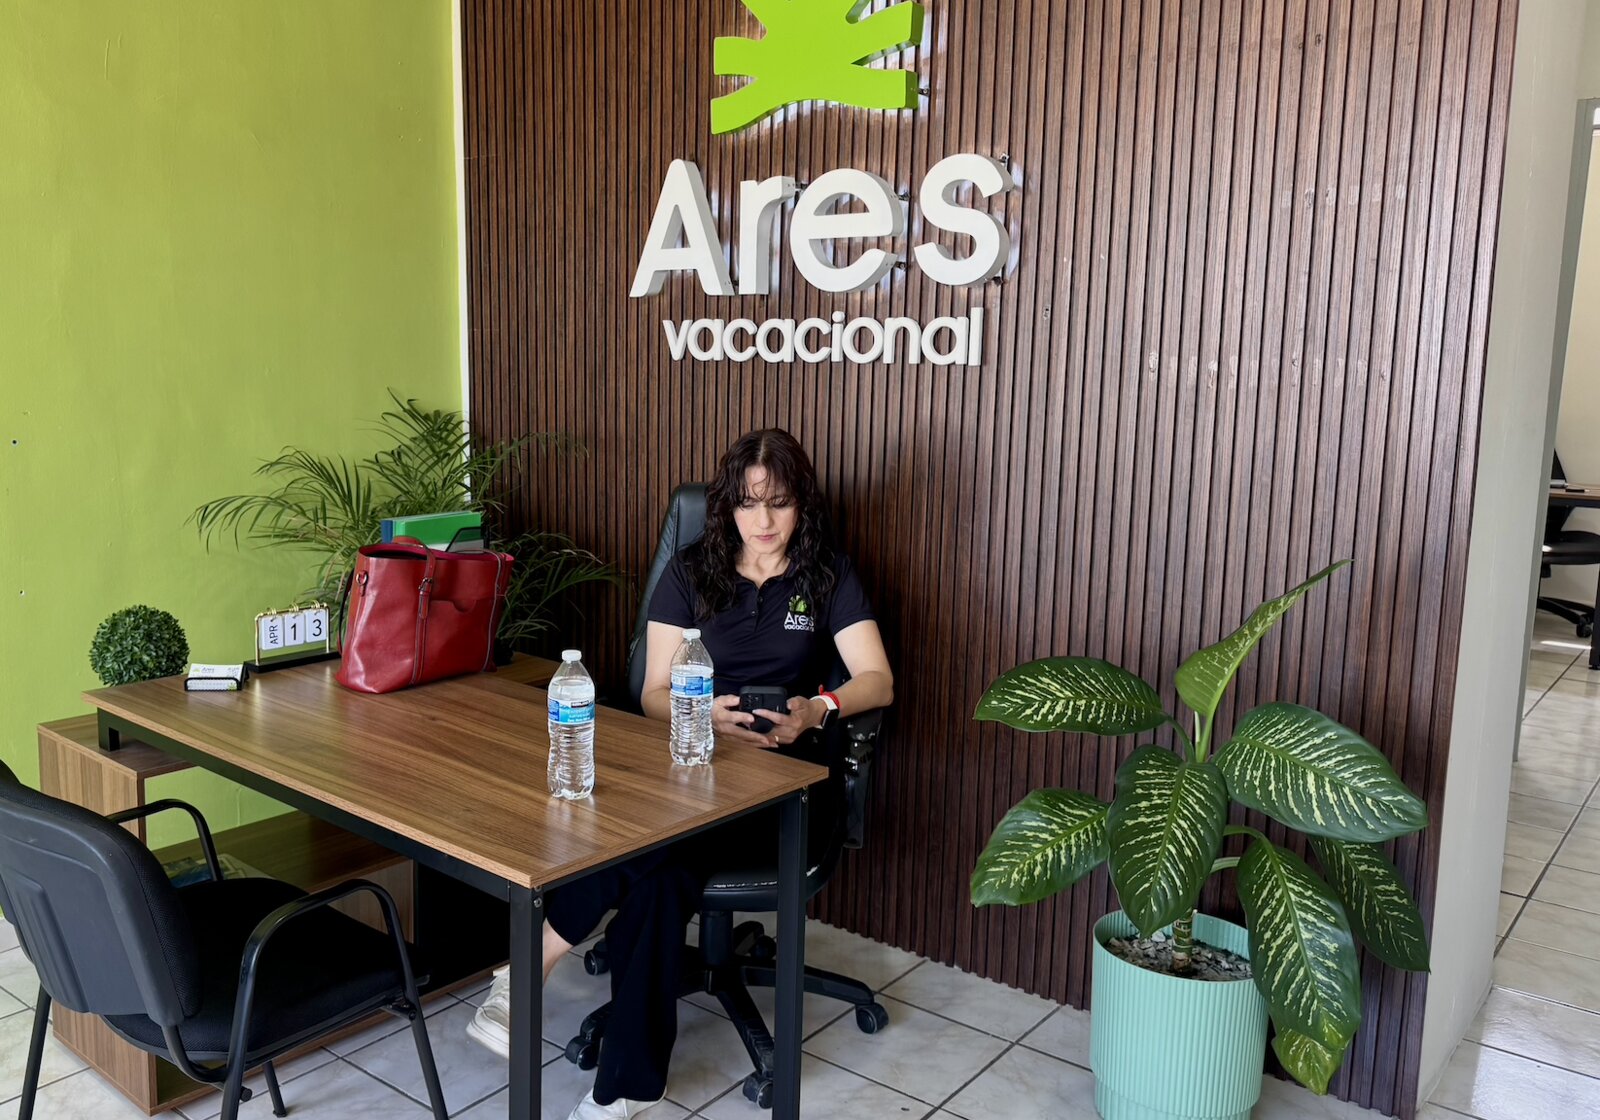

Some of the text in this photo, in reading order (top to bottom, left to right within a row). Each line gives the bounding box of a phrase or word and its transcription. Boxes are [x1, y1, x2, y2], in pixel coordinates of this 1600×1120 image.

[629, 153, 1010, 298] Ares
[662, 307, 984, 366] vacacional
[269, 624, 279, 645] APR
[784, 611, 814, 627] Ares
